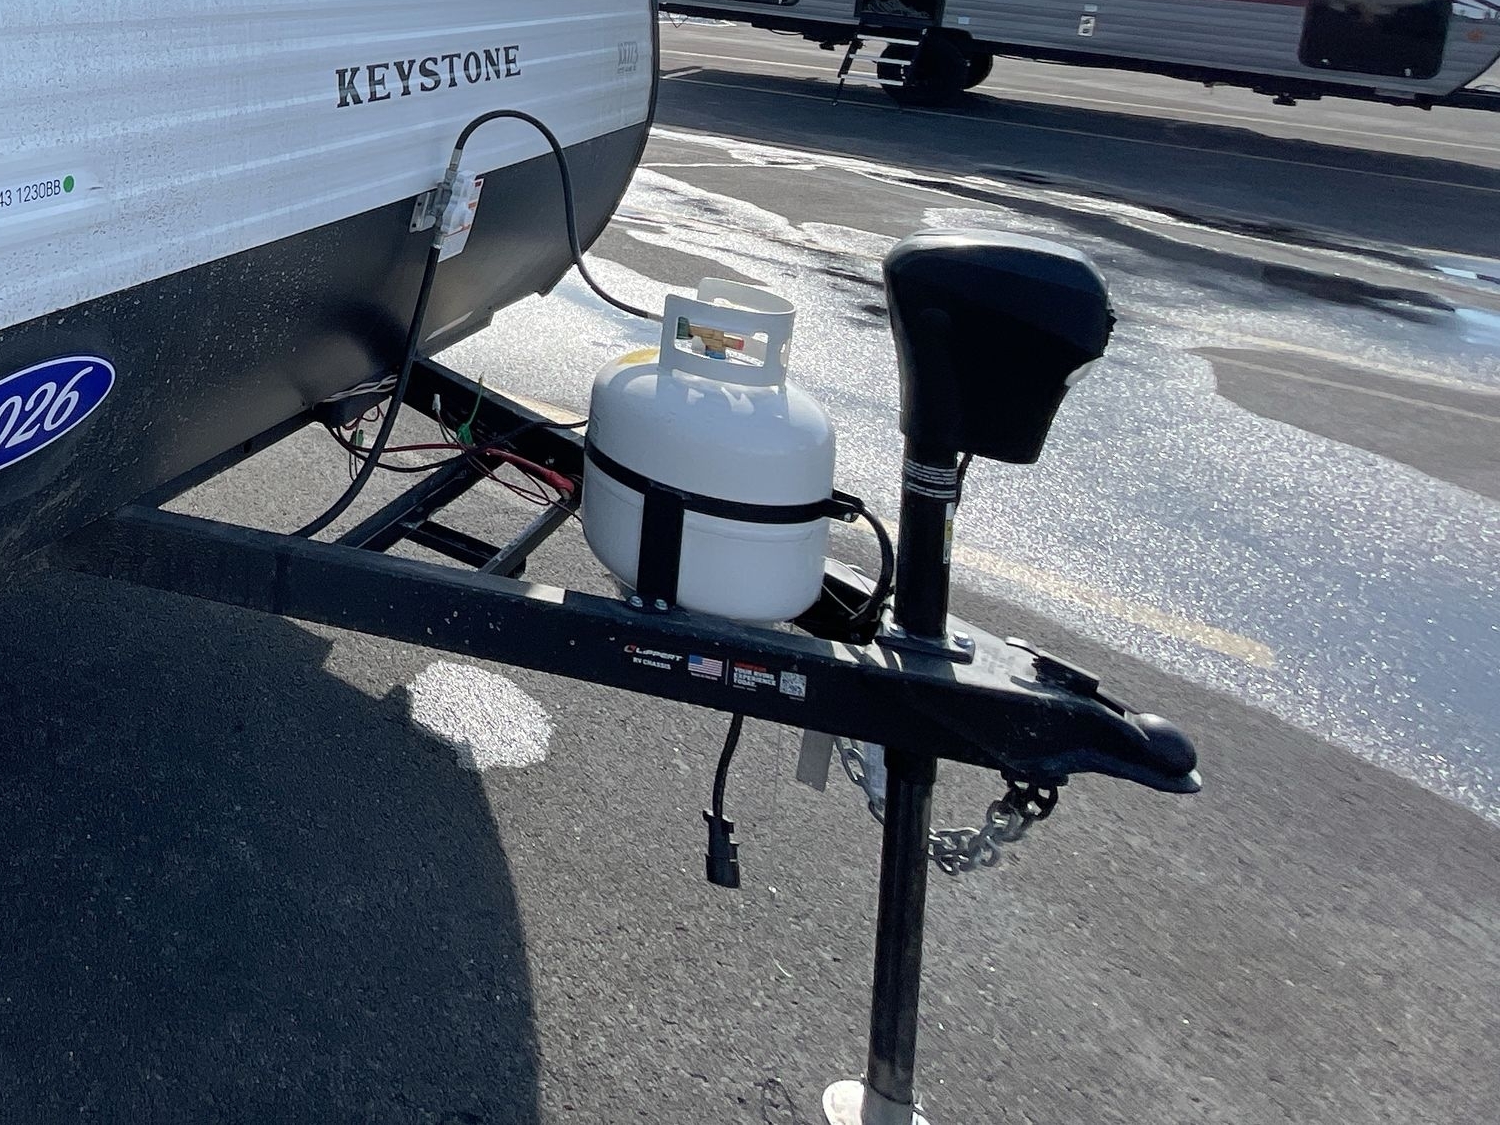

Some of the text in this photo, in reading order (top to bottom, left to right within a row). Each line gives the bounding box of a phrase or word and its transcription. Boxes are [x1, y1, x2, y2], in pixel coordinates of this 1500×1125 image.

[335, 45, 522, 108] KEYSTONE
[15, 179, 61, 204] 1230BB
[635, 647, 683, 662] LIPPERT
